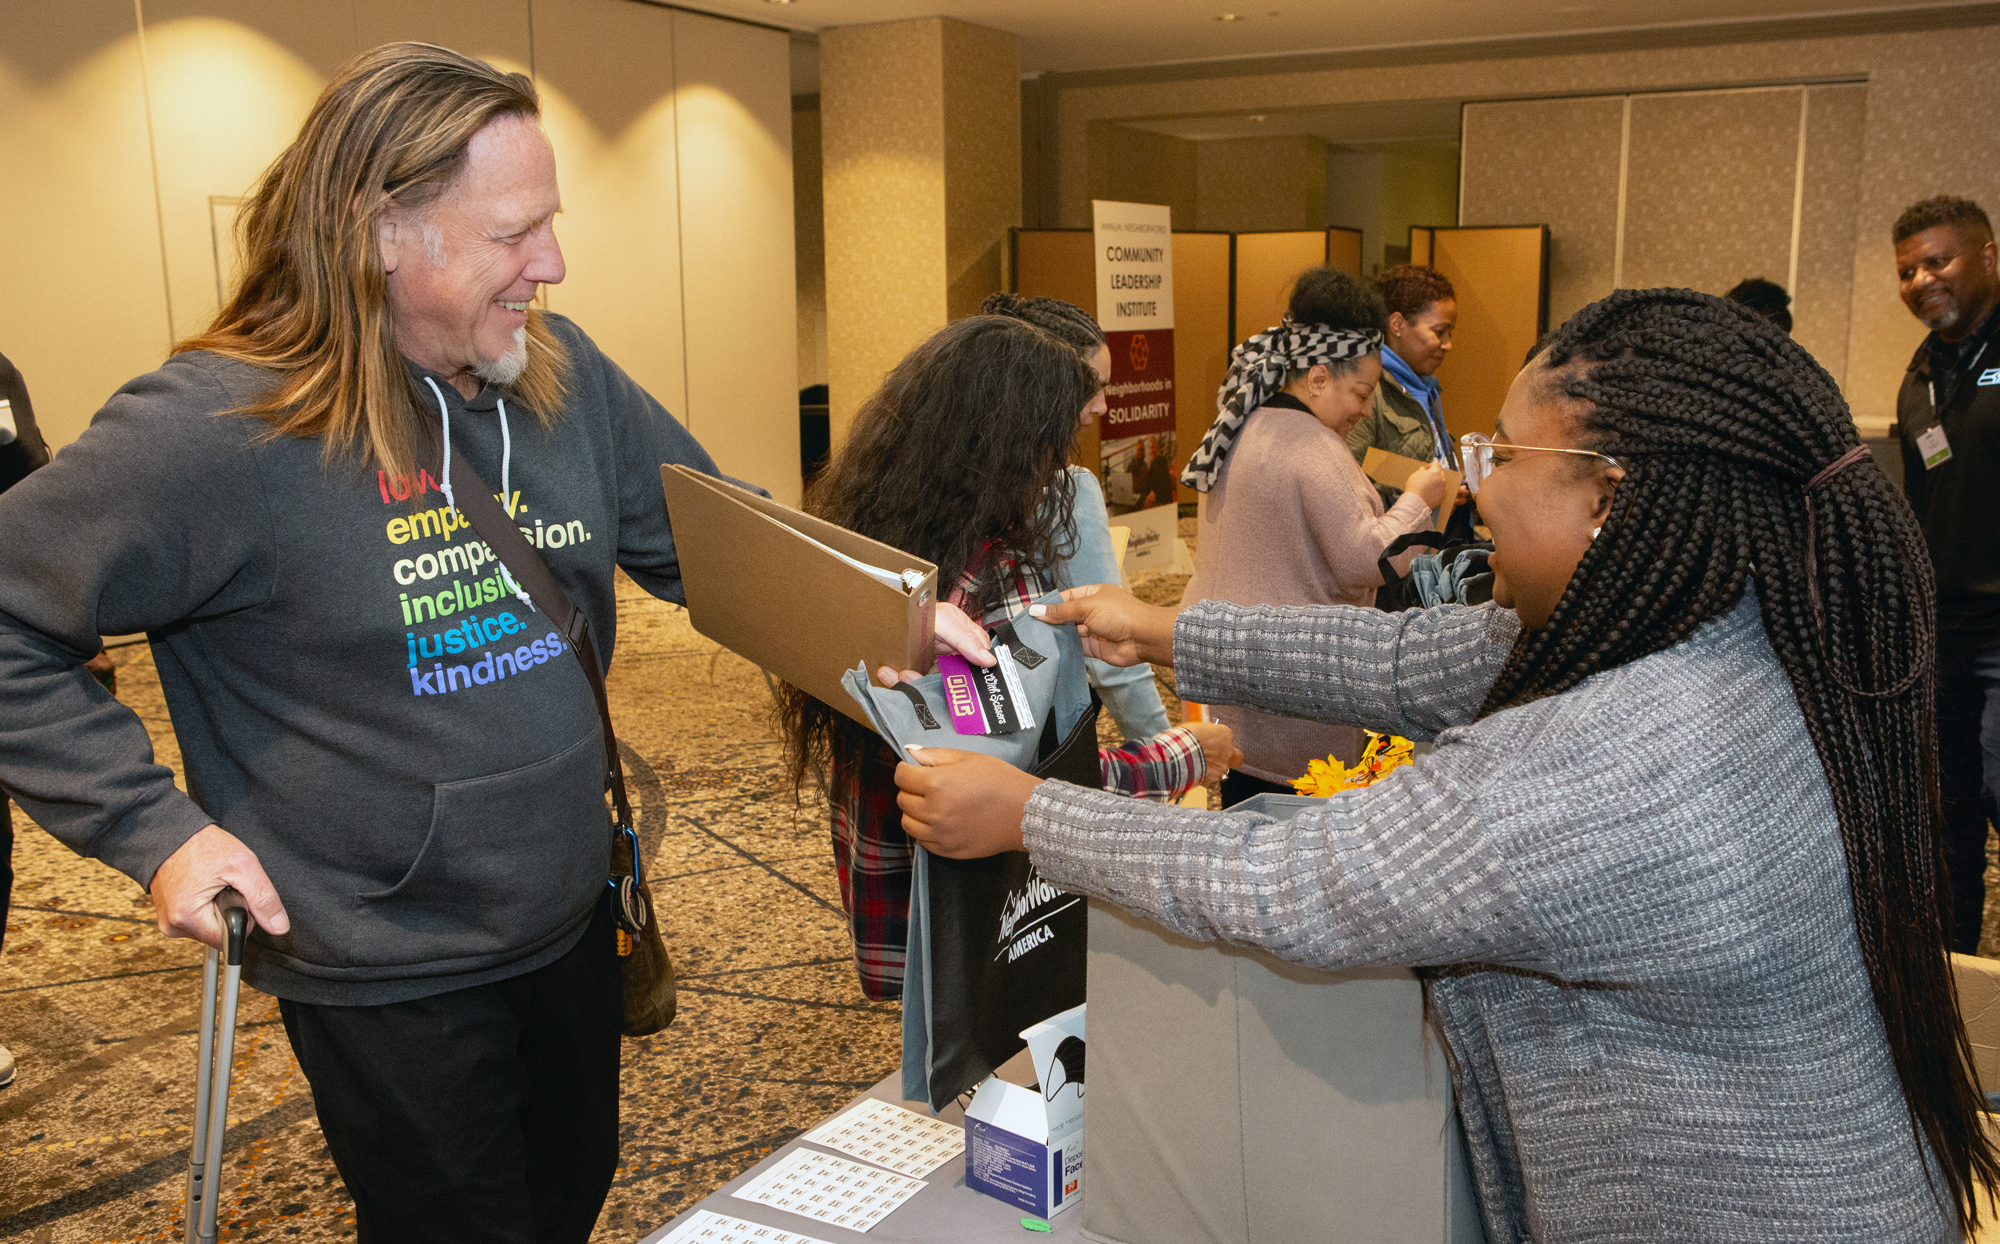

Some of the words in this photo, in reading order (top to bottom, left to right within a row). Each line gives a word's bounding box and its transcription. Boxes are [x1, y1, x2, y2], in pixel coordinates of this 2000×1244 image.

[1106, 245, 1164, 262] COMMUNITY
[1111, 273, 1163, 290] LEADERSHIP
[1116, 301, 1157, 317] INSTITUTE
[1105, 379, 1164, 398] Neighborhoods
[1164, 378, 1172, 390] in
[1109, 402, 1170, 425] SOLIDARITY
[406, 611, 527, 669] justice.
[410, 632, 568, 697] kindness.
[984, 673, 1001, 694] With
[947, 674, 976, 717] OMG
[989, 694, 1007, 725] Scissors
[1008, 924, 1055, 964] AMERICA
